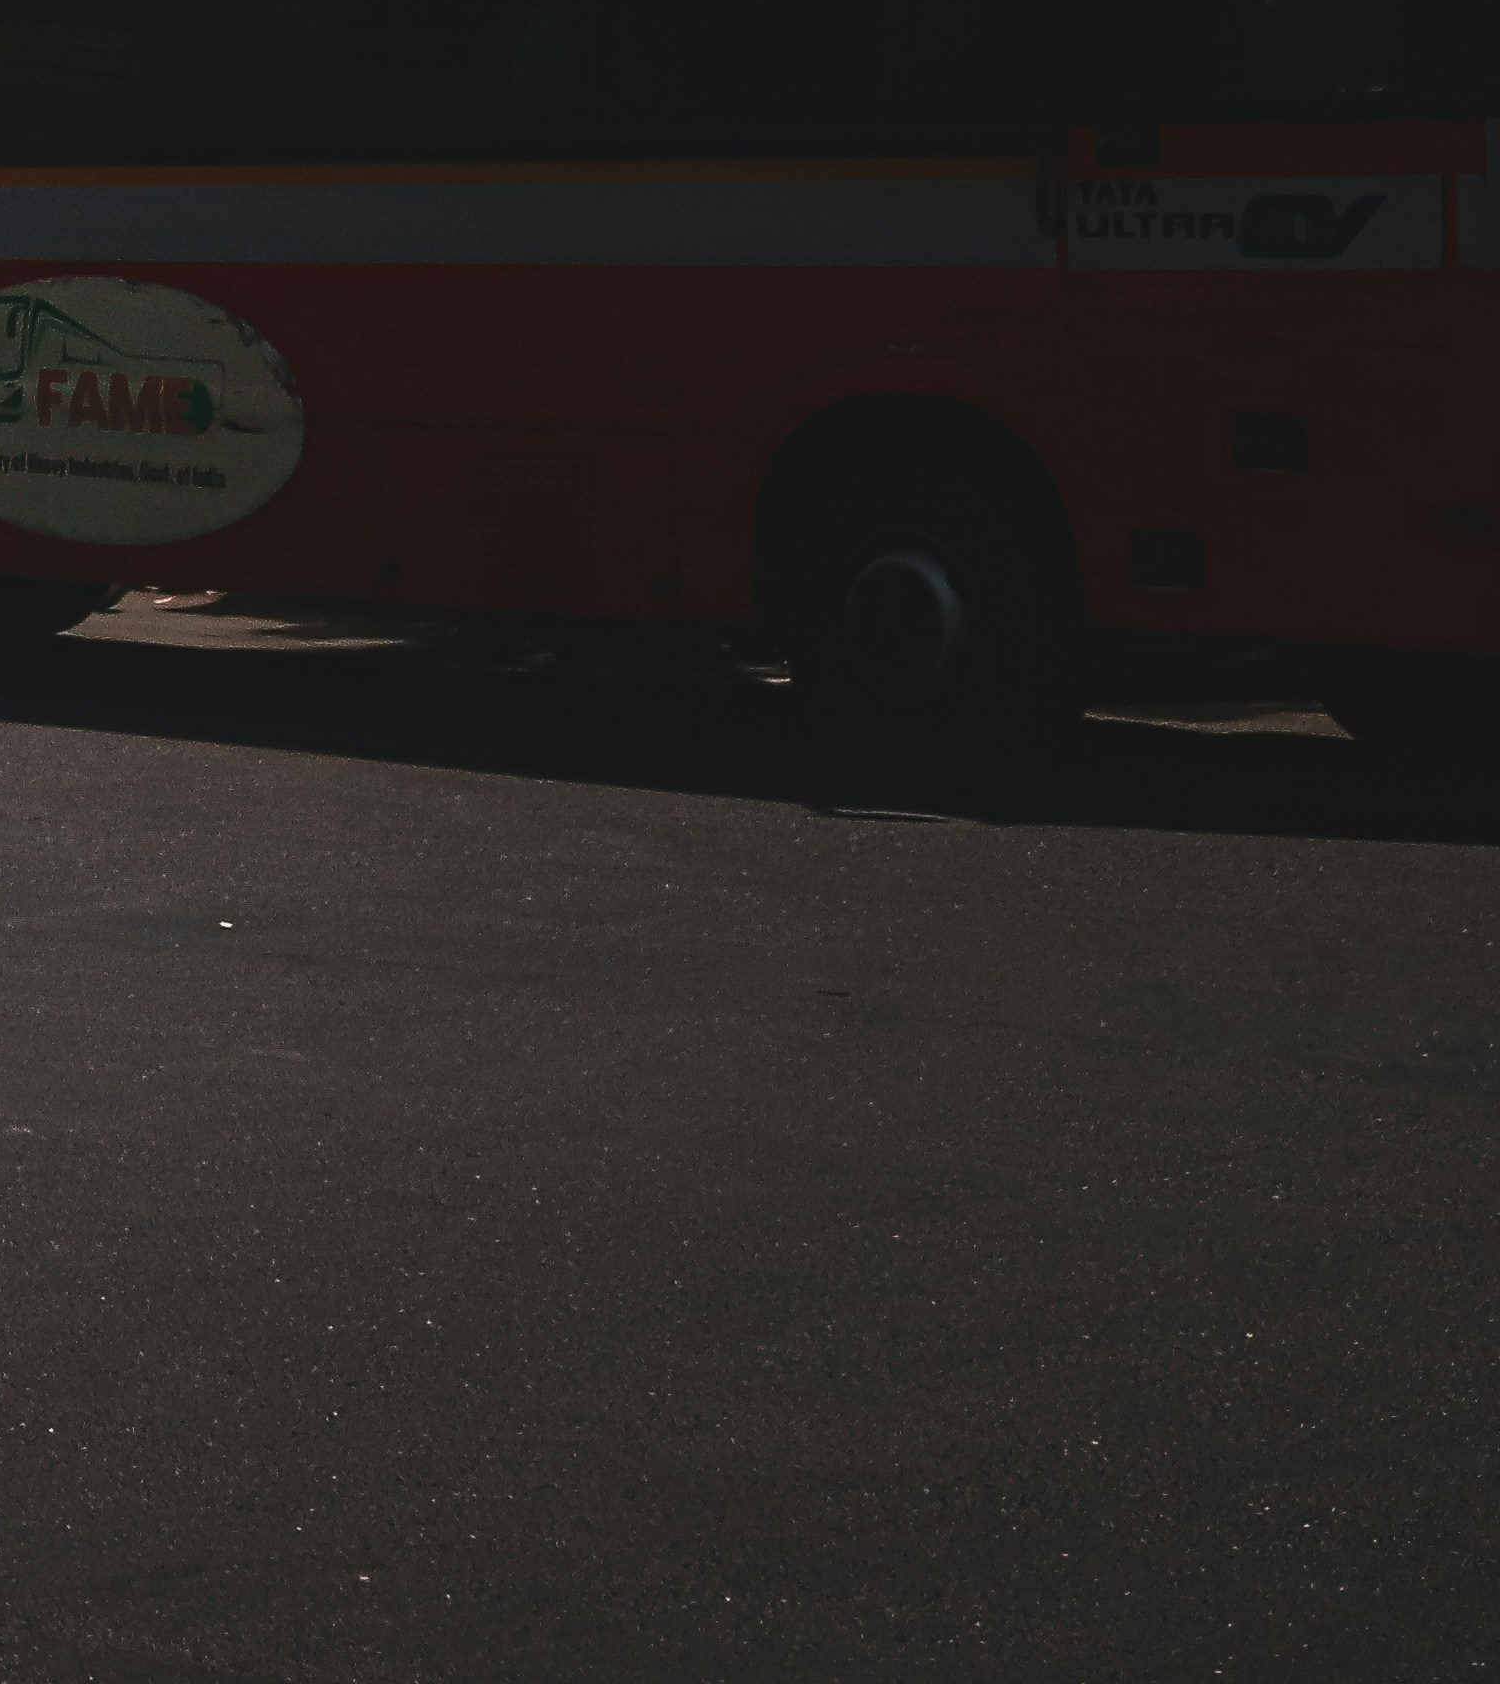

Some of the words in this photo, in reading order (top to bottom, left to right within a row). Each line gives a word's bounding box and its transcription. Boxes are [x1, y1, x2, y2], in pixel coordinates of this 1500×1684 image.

[1076, 180, 1159, 206] TATA
[1076, 212, 1236, 239] ULTRA
[36, 367, 214, 437] FAME
